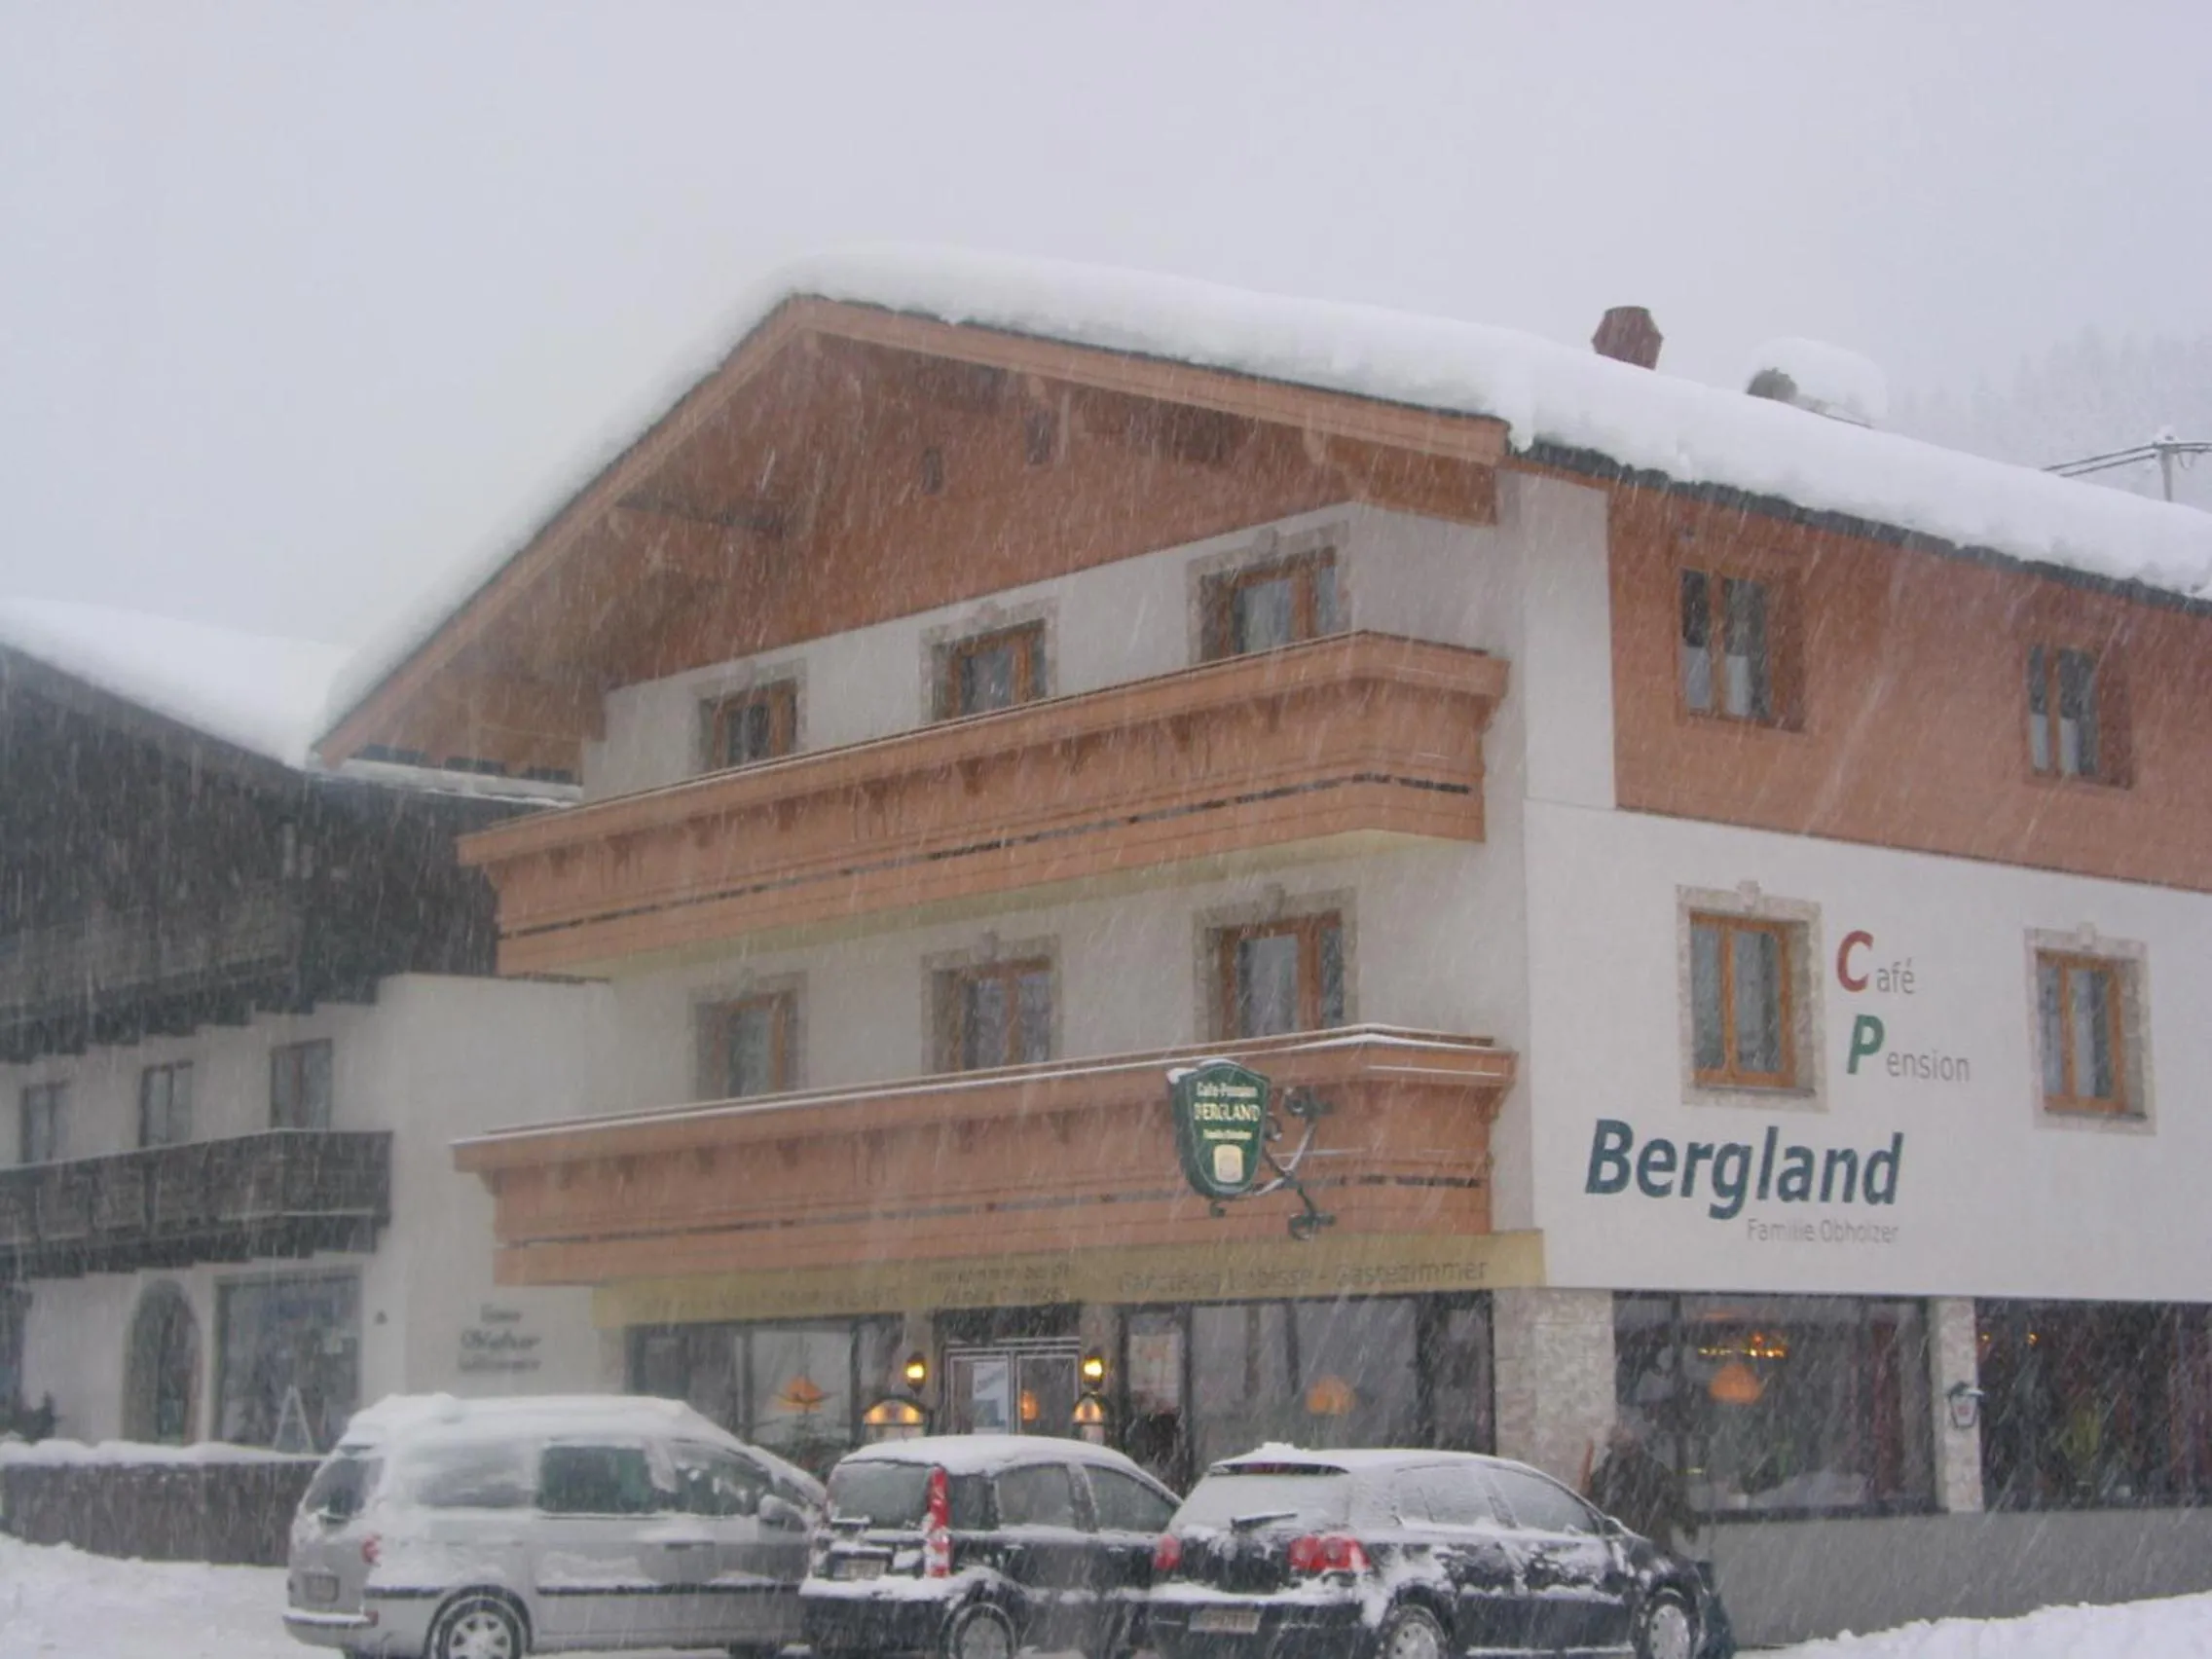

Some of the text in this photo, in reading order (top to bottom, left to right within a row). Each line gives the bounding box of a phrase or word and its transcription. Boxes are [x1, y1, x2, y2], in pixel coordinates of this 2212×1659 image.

[1836, 930, 1916, 995] Café
[1846, 1014, 1971, 1082] Pension
[1585, 1119, 1904, 1220] Bergland
[1747, 1215, 1815, 1241] Familie
